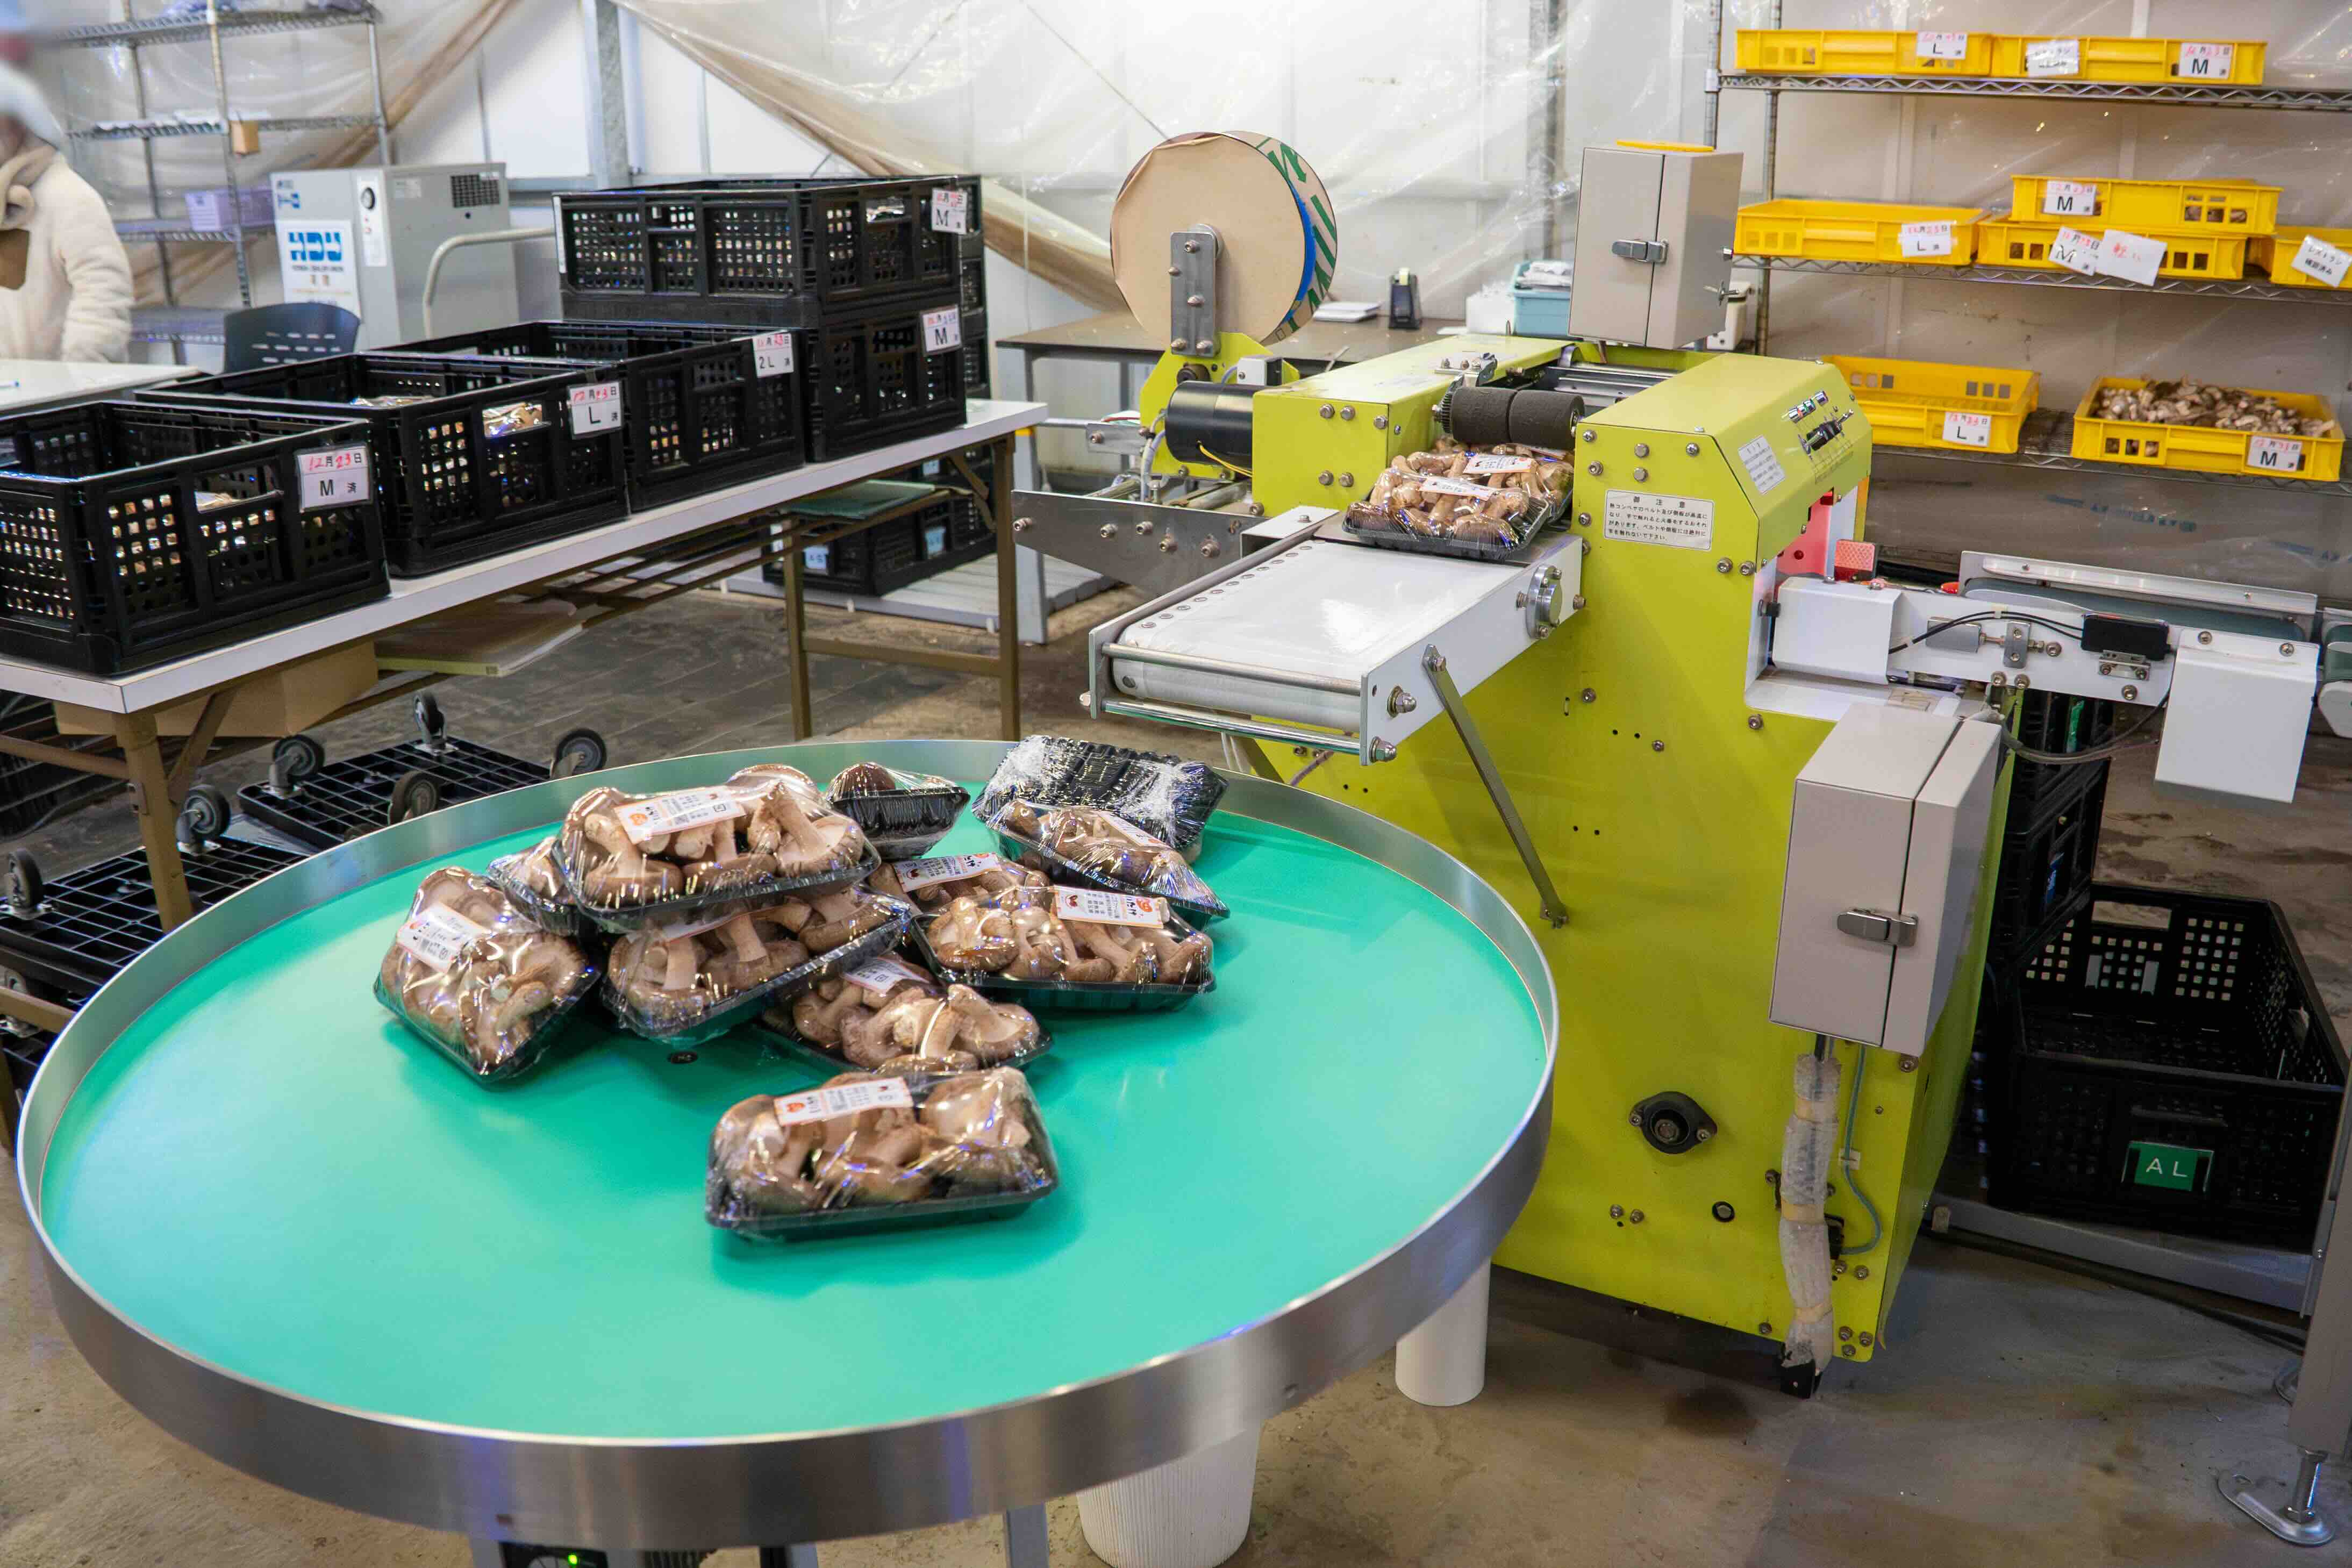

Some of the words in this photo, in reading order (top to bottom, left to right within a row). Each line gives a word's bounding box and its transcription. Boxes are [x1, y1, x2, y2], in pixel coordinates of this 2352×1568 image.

[1933, 43, 1943, 54] L
[2192, 58, 2208, 74] M
[2057, 196, 2073, 211] M
[936, 209, 948, 226] M
[1917, 240, 1927, 250] L
[2056, 245, 2076, 262] M
[934, 328, 948, 345] M
[589, 406, 601, 424] L
[1957, 425, 1967, 439] L
[2260, 451, 2277, 467] M
[319, 478, 334, 497] M
